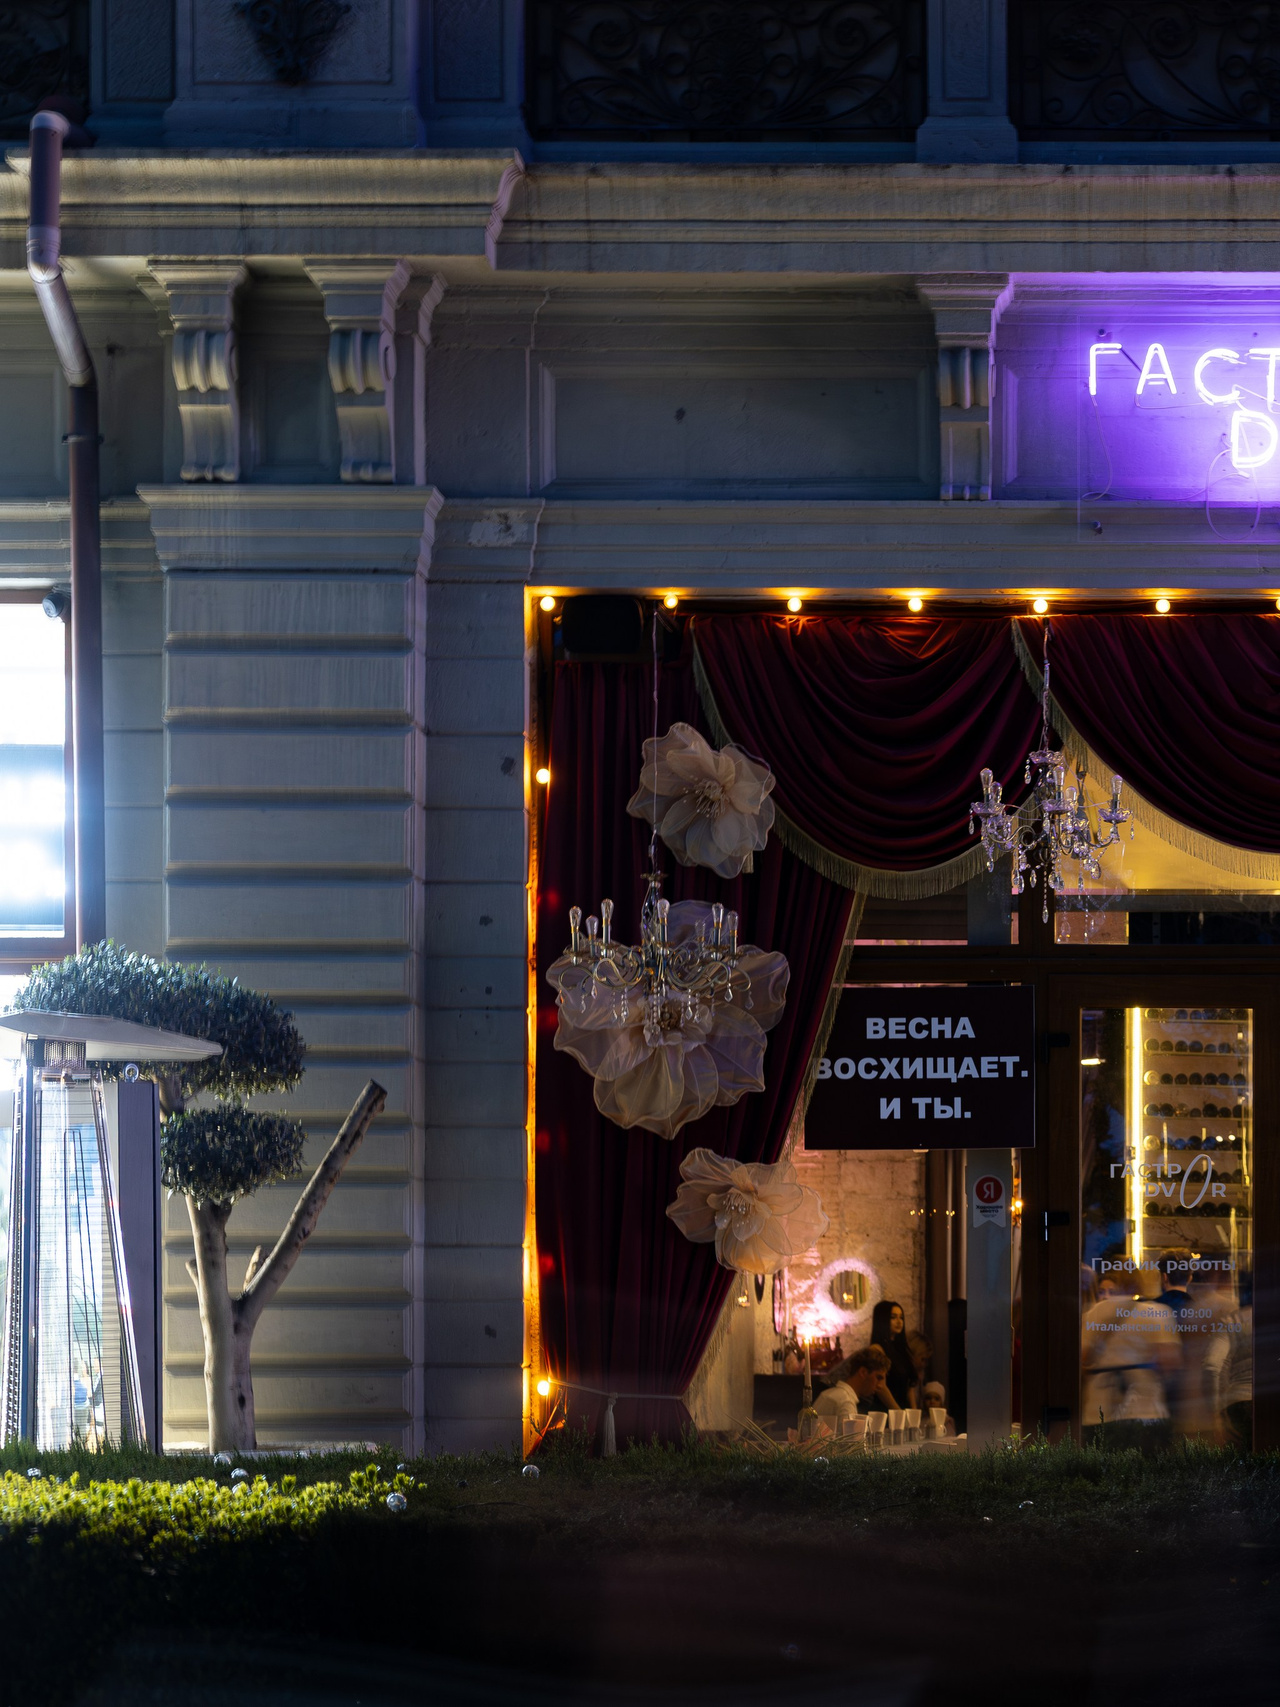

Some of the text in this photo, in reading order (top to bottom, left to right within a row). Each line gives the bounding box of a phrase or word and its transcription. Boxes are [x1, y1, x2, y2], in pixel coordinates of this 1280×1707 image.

[866, 1017, 976, 1039] ВЕСНА
[813, 1056, 1029, 1083] ВОСХИЩАЕТ.
[880, 1097, 972, 1120] И ТЫ.
[1091, 1257, 1236, 1273] График работы
[1116, 1307, 1168, 1319] Кофейня
[1180, 1308, 1213, 1319] 09:00
[1210, 1322, 1242, 1333] 12:00
